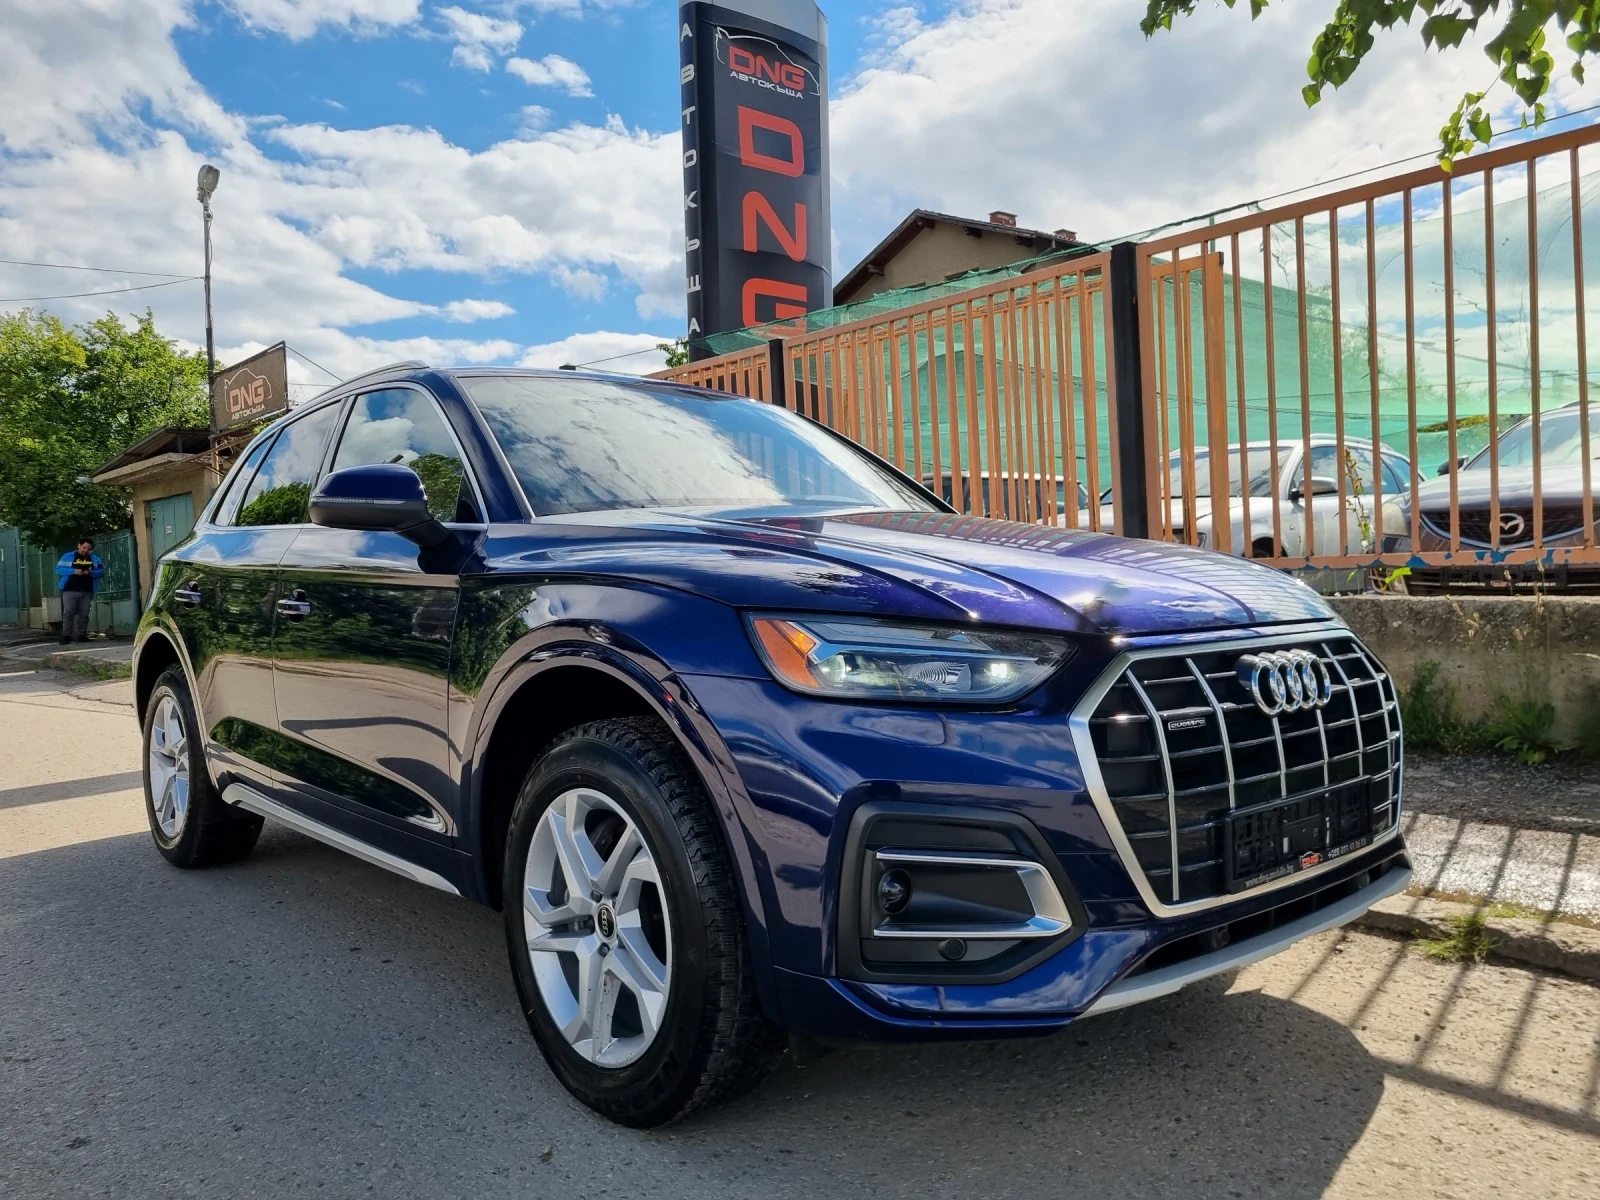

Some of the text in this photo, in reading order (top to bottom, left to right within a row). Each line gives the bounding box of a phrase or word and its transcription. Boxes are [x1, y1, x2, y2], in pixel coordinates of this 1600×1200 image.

[729, 45, 805, 91] DNG
[738, 105, 807, 337] DNG
[229, 378, 265, 413] DNG
[1170, 718, 1206, 729] quattro
